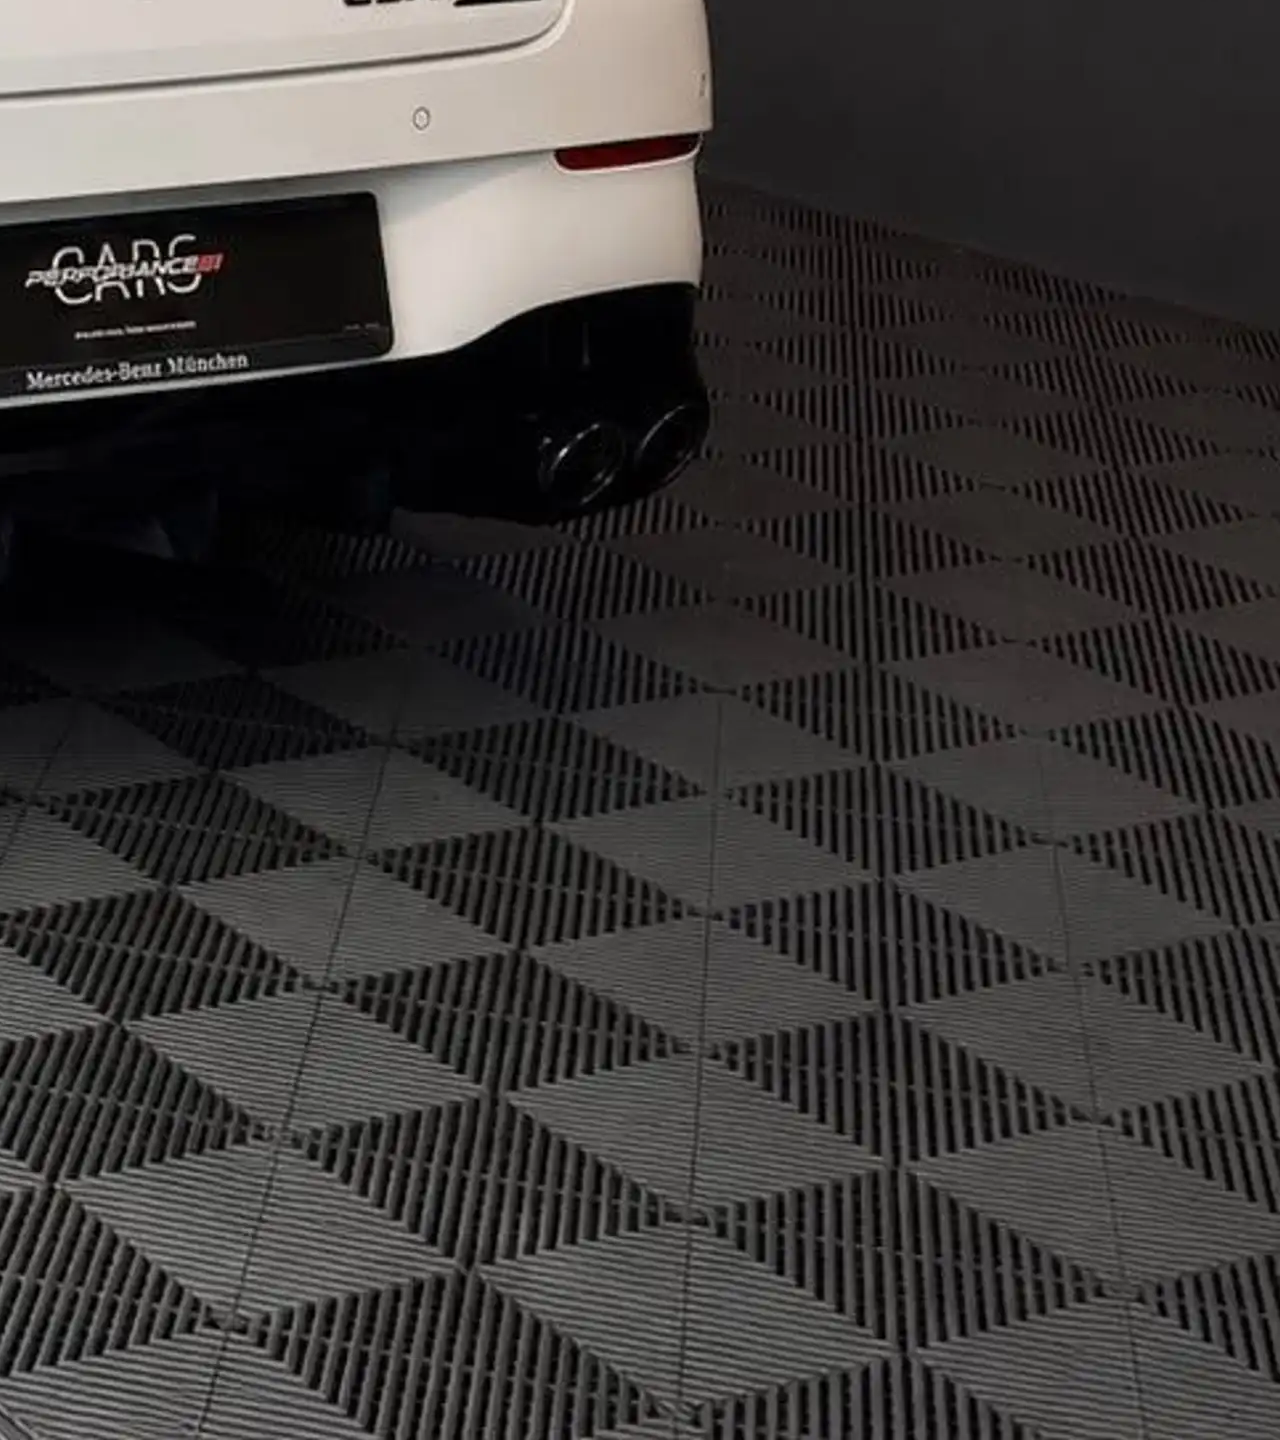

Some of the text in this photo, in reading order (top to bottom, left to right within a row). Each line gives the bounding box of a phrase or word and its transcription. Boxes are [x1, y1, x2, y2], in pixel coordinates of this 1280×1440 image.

[52, 233, 202, 305] CARS
[26, 353, 249, 390] Mercedes-Benz München
